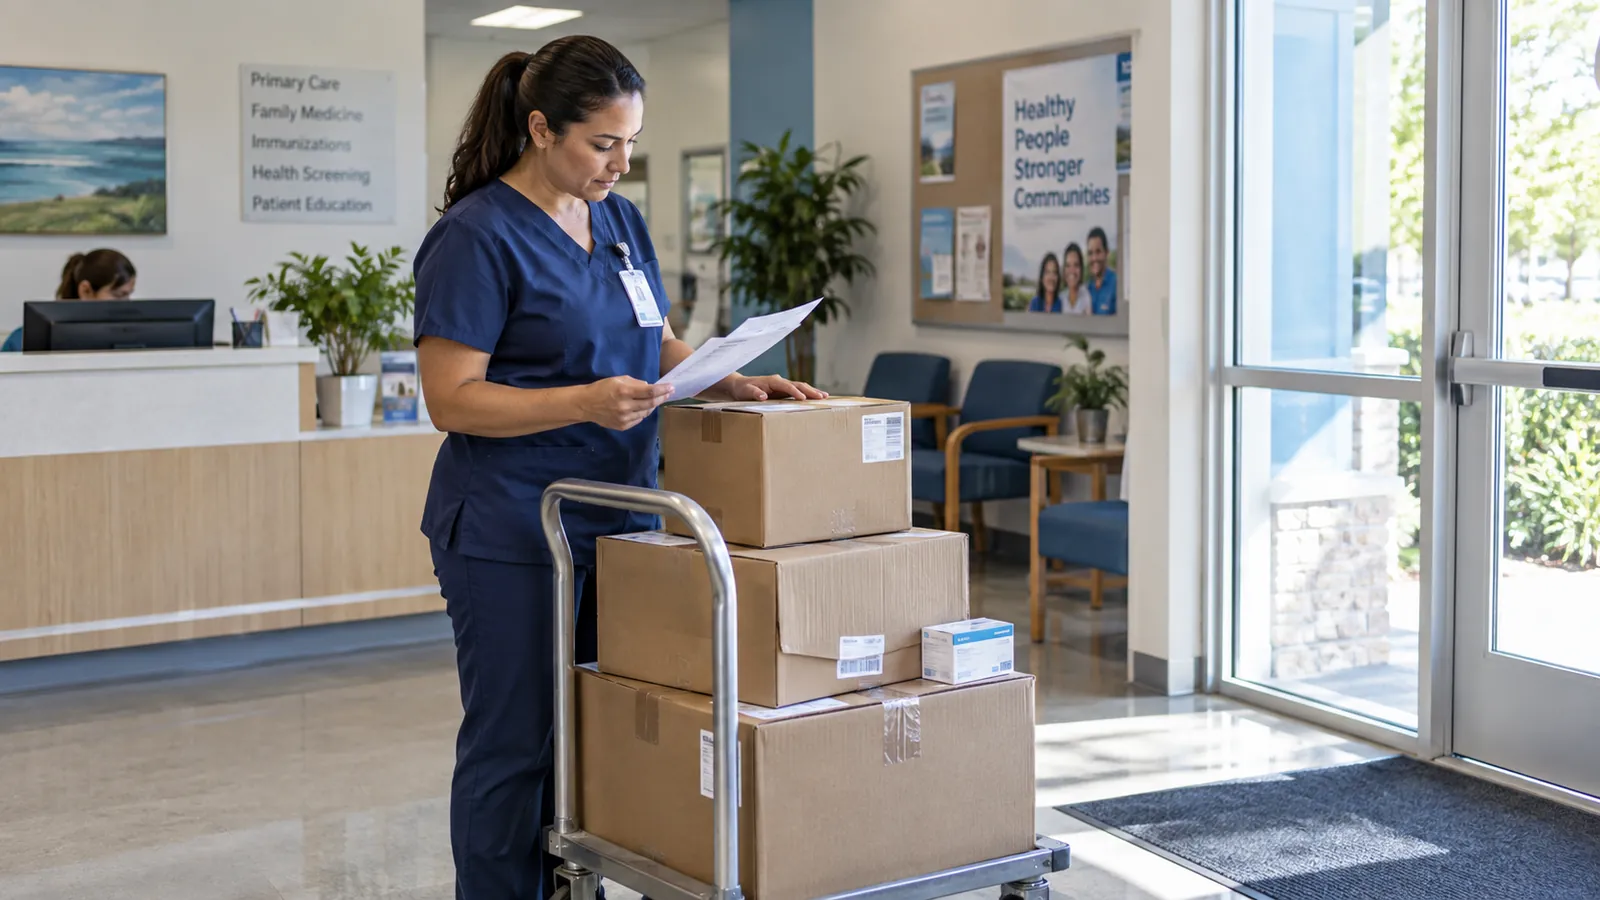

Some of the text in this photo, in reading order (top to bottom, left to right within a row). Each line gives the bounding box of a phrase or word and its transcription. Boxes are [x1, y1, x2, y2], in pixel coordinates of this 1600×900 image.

[250, 72, 341, 93] Primary Care
[251, 103, 364, 123] Family Medicine
[1014, 94, 1076, 122] Healthy
[251, 134, 352, 152] Immunizations
[1014, 125, 1070, 153] People
[252, 165, 371, 186] Health Screening
[1014, 157, 1084, 183] Stronger
[252, 195, 373, 212] Patient Education
[1014, 184, 1110, 209] Communities
